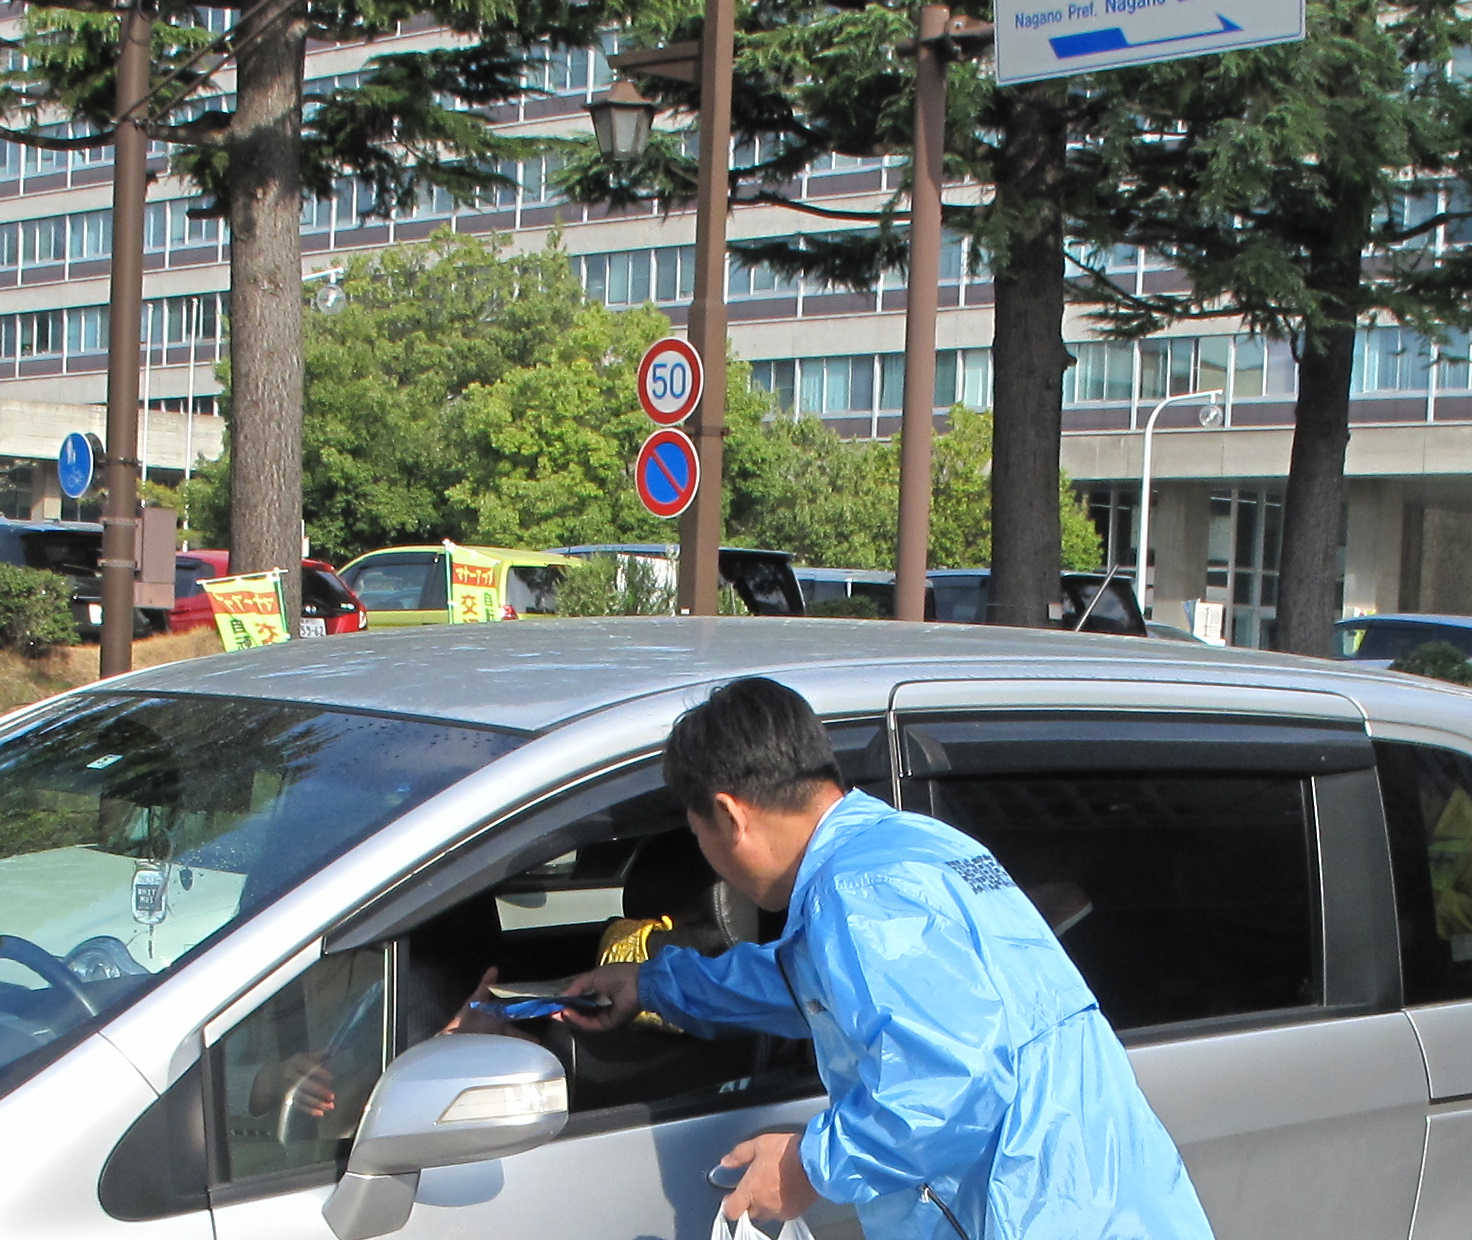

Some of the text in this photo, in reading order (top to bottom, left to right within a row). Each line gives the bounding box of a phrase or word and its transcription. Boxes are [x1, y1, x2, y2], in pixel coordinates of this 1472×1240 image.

[1014, 9, 1063, 29] Nagano
[1068, 3, 1097, 20] Pref.
[652, 362, 687, 399] 50
